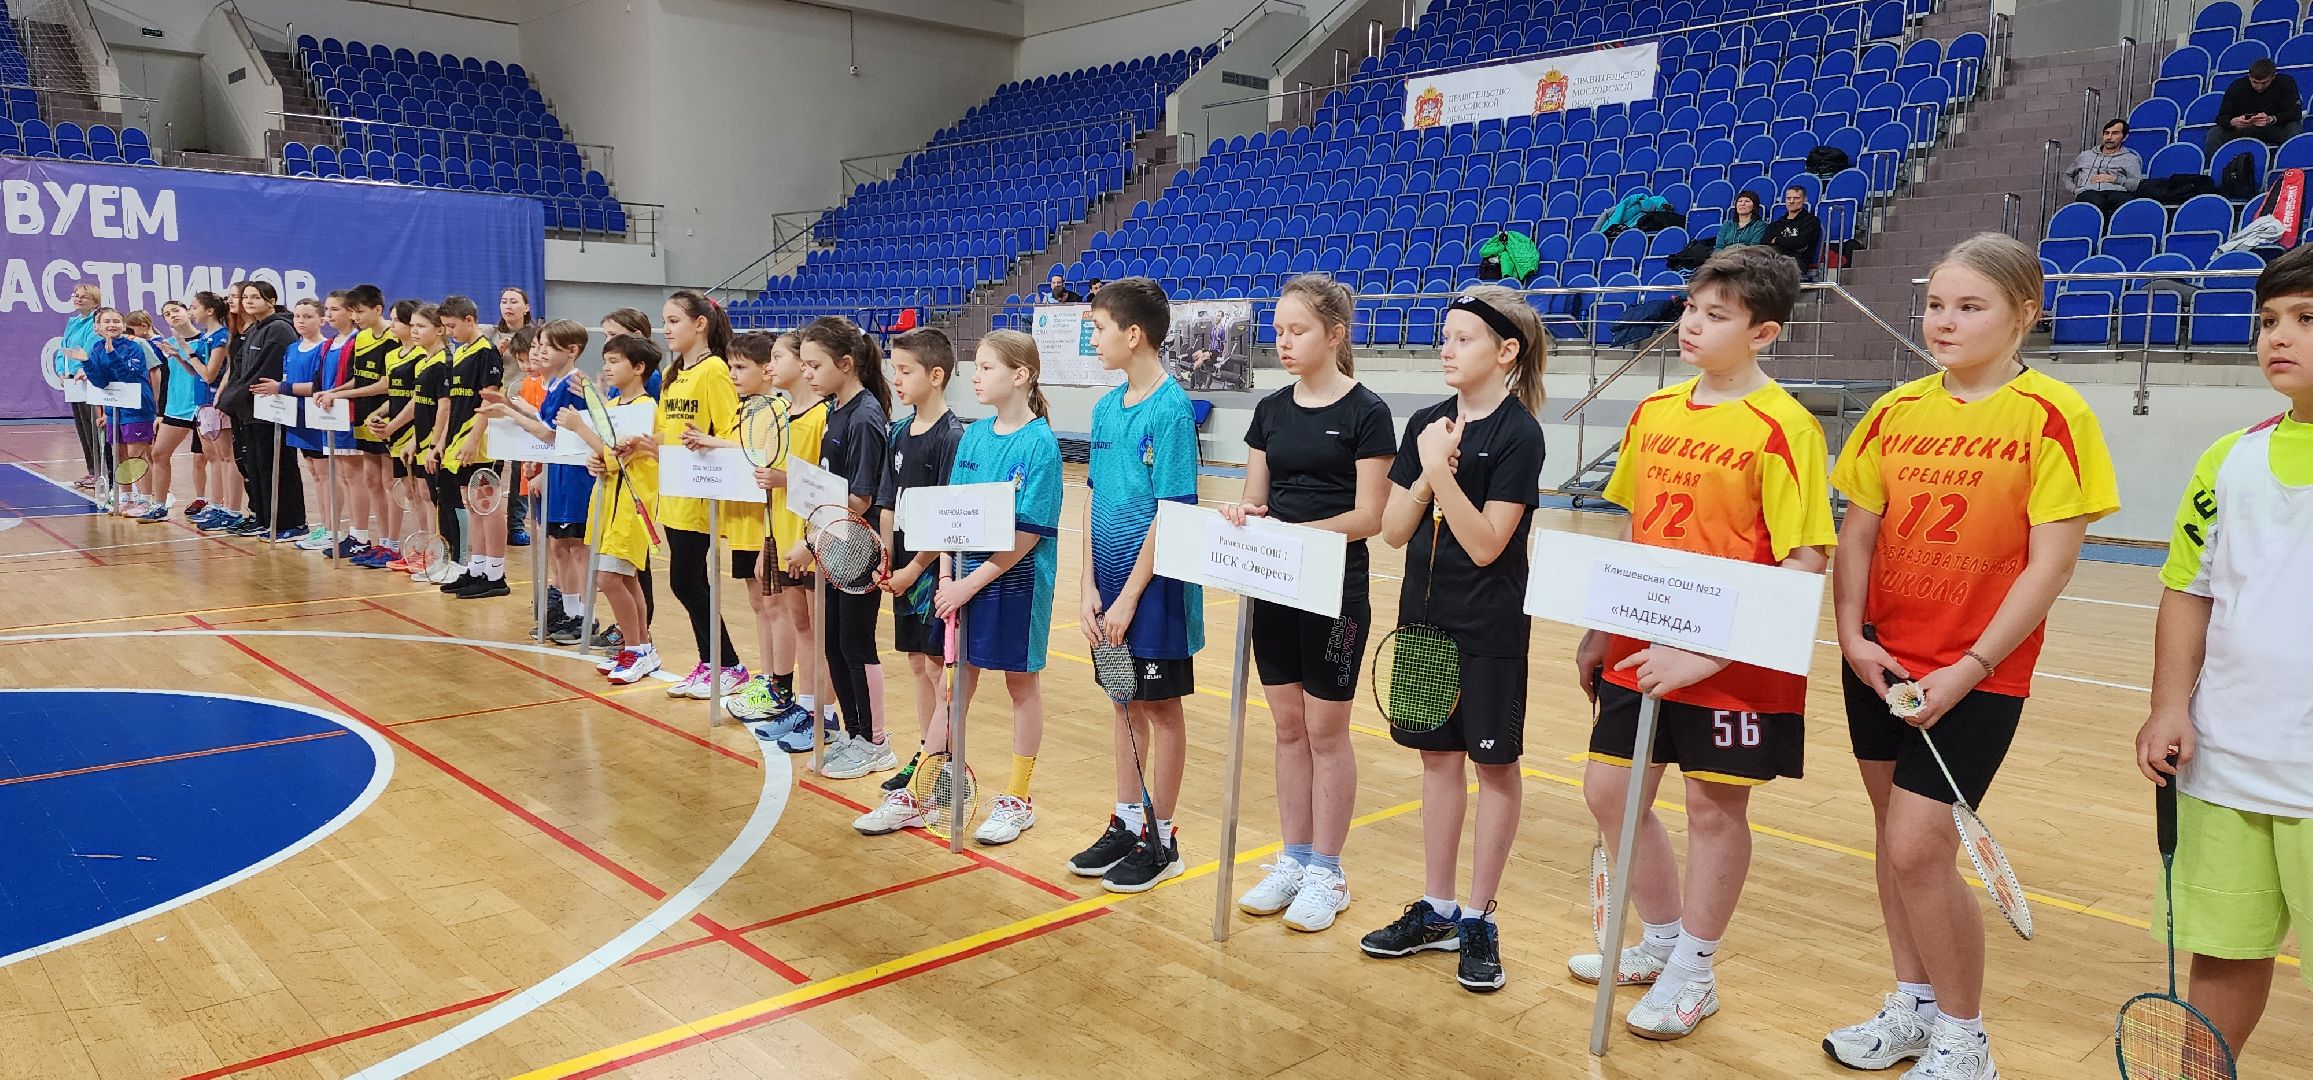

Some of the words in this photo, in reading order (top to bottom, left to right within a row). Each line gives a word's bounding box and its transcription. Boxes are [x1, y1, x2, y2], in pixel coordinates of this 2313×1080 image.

[1572, 82, 1633, 98] МОСКОВСКОЙ
[0, 180, 179, 241] ВУЕМ
[1898, 466, 1984, 488] СРЕДНЯЯ
[1642, 490, 1695, 540] 12
[1896, 491, 1969, 545] 12
[1211, 551, 1240, 568] ШСК
[1241, 560, 1294, 582] «Эверест»
[1260, 546, 1282, 559] СОШ
[1604, 564, 1665, 585] Клишевская
[1667, 577, 1694, 592] СОШ
[1696, 583, 1722, 597] №12
[1880, 569, 1969, 606] ШКОЛА
[1647, 591, 1672, 605] ШСК
[1611, 604, 1702, 634] «НАДЕЖДА»
[1712, 710, 1761, 749] 56
